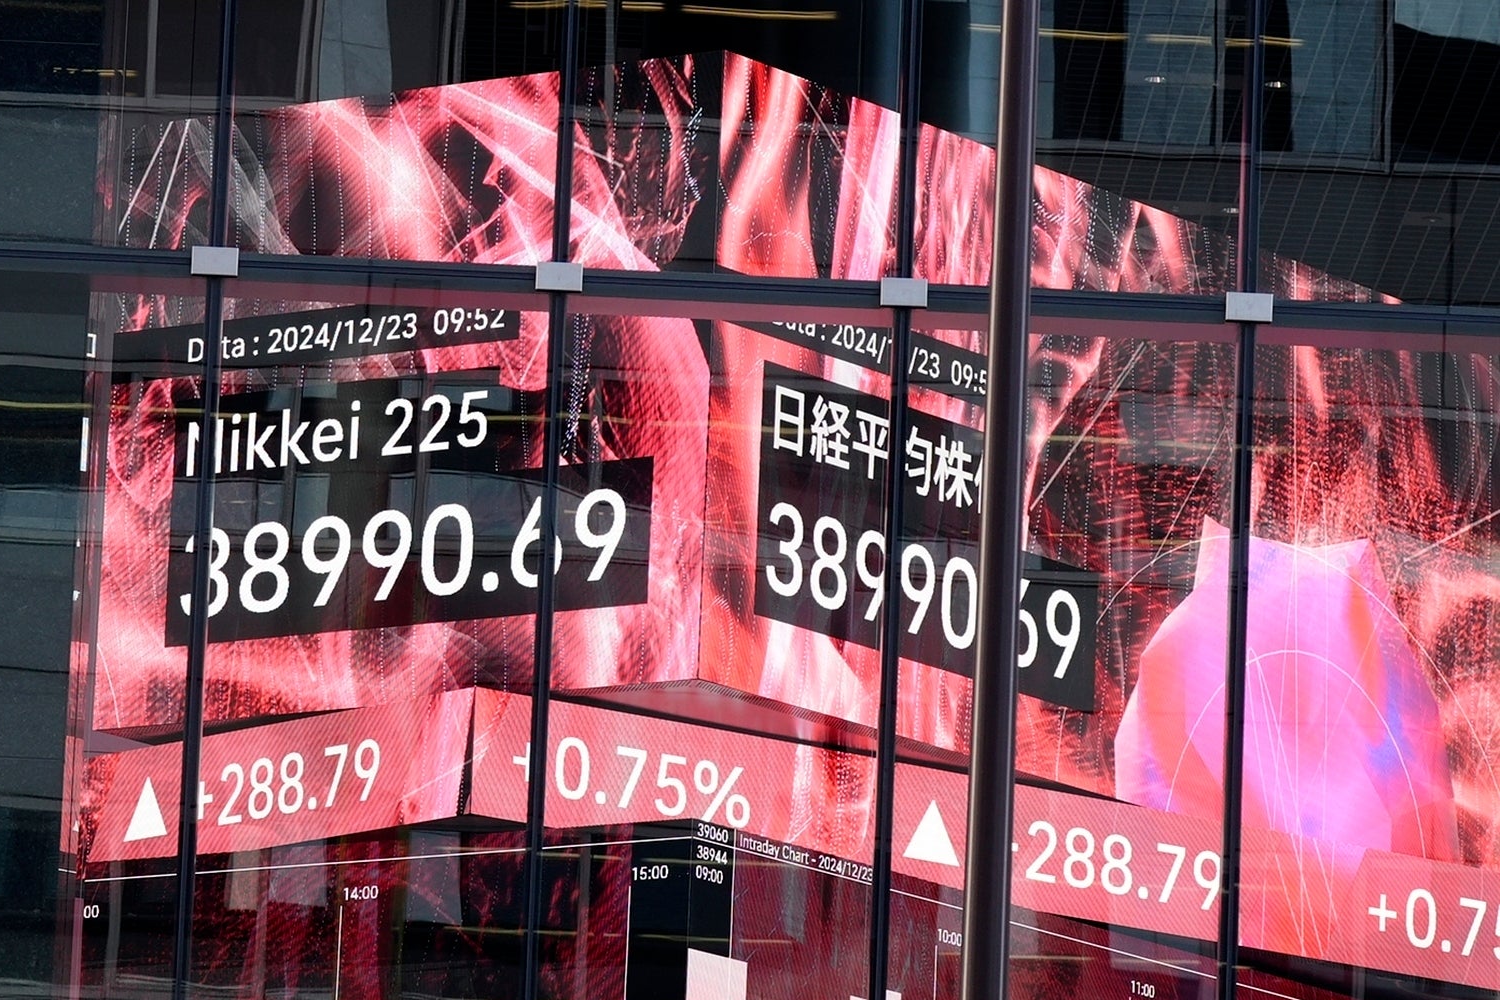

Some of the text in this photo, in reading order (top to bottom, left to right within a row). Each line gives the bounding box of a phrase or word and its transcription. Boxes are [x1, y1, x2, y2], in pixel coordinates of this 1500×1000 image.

[187, 332, 245, 363] Dta
[267, 312, 418, 354] 2024/12/23
[433, 308, 505, 336] 09:52
[772, 322, 816, 341] ata
[831, 324, 941, 378] 2024//23
[951, 360, 988, 395] 09:5
[186, 390, 489, 477] Nikkei 225
[773, 385, 984, 514] 日経平均株
[179, 488, 627, 619] 38990.69
[197, 738, 380, 826] +288.79
[696, 845, 728, 865] 38944
[697, 823, 728, 843] 39060
[739, 834, 780, 859] Intraday
[782, 846, 809, 865] Chart
[818, 855, 873, 882] 2024/12/23
[632, 865, 668, 881] 15:00
[695, 865, 723, 884] 09:00
[1012, 820, 1221, 910] 288.79
[343, 885, 379, 901] 14:00
[938, 928, 962, 947] 10:00
[1368, 888, 1500, 961] +0.7
[1130, 980, 1155, 998] 11:00
